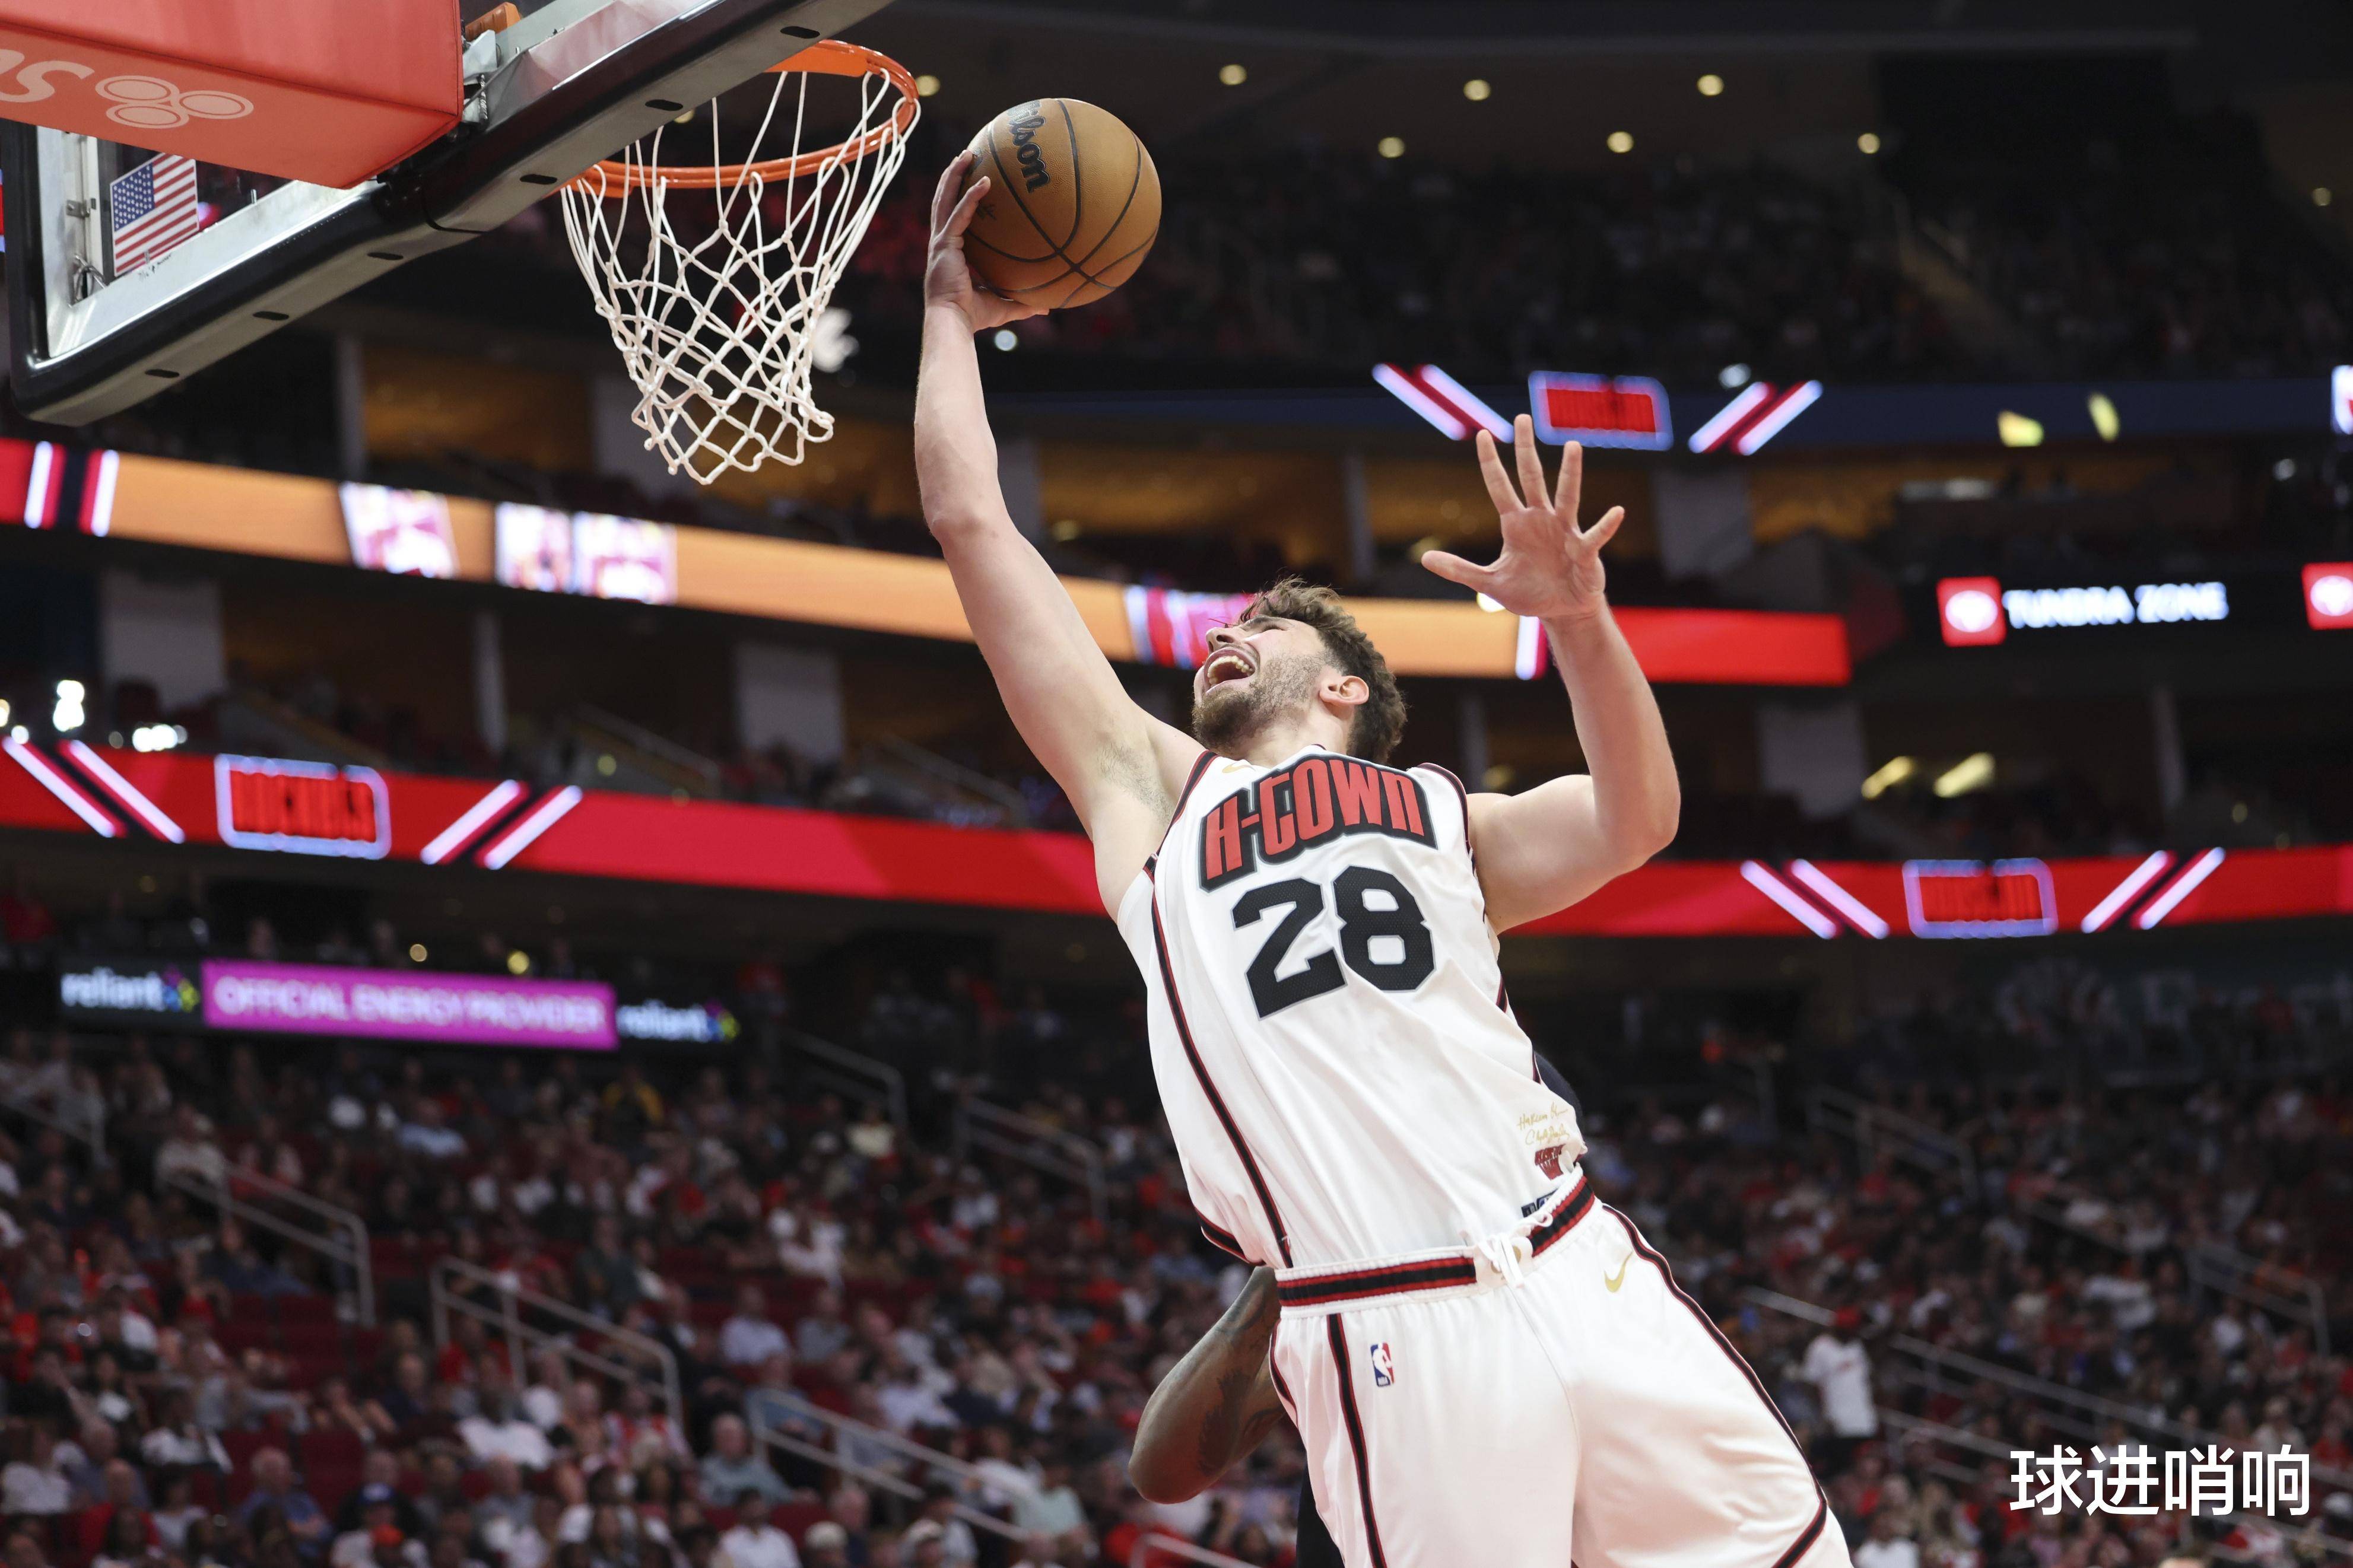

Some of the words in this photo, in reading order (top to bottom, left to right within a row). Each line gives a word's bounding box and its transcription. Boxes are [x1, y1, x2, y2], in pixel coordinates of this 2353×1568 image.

[2002, 586, 2135, 629] TUNDRA
[2135, 581, 2229, 623] ZONE
[1231, 865, 1437, 1020] 28
[61, 967, 164, 1011] reliant
